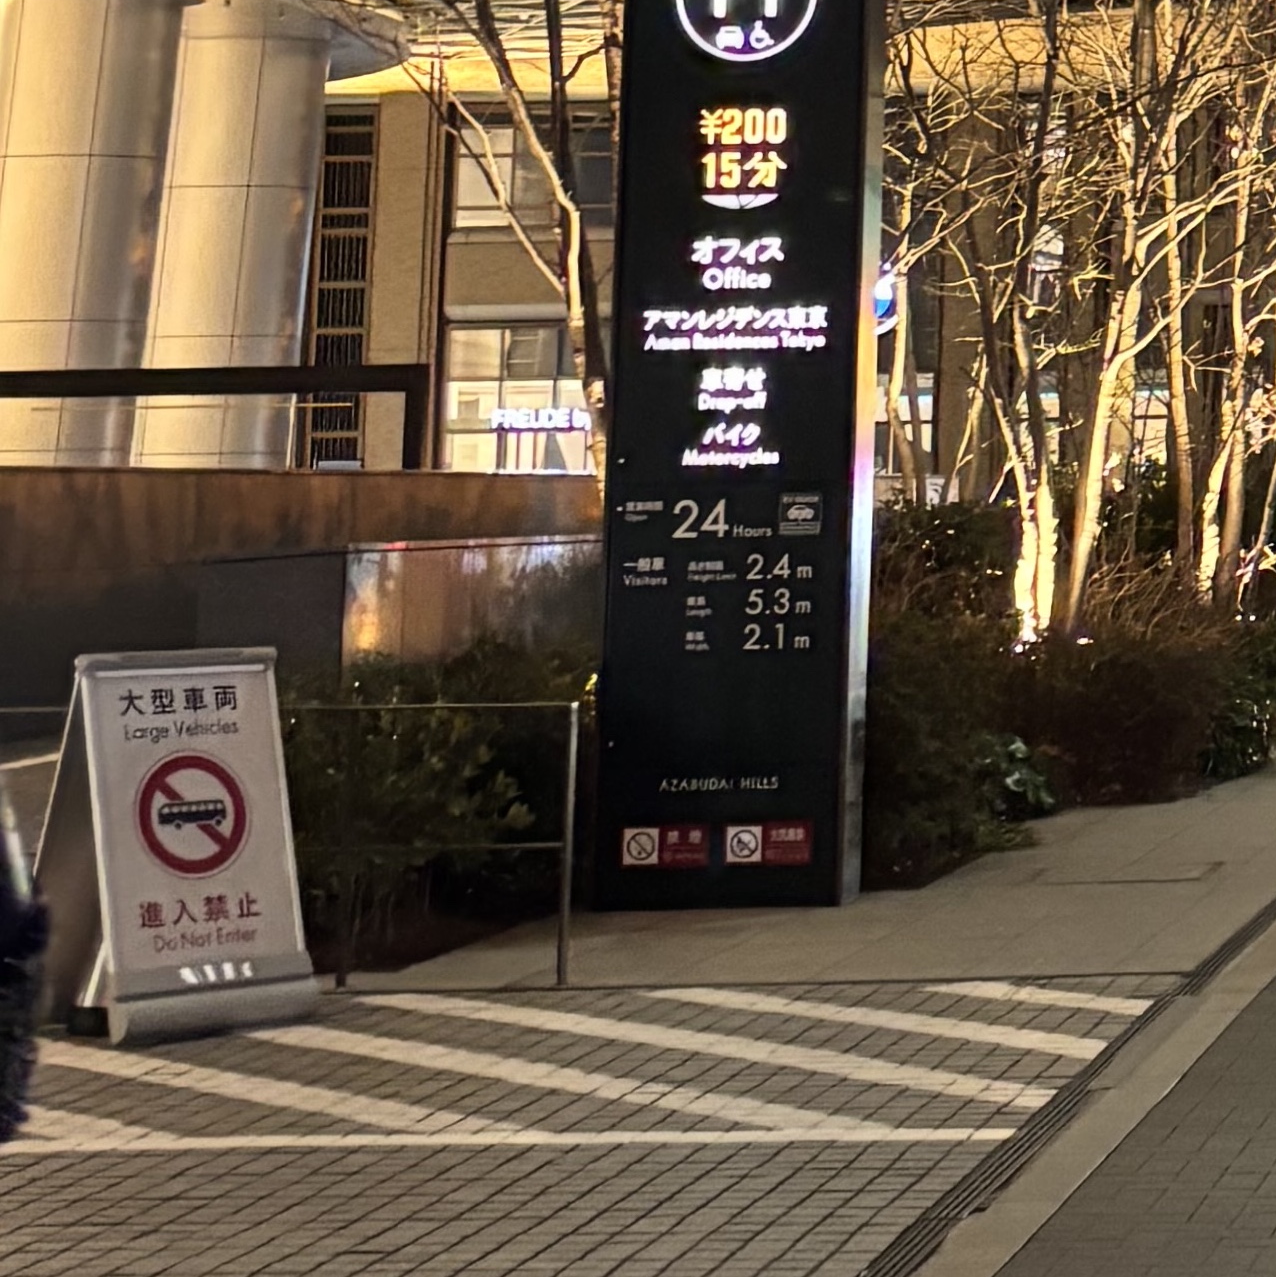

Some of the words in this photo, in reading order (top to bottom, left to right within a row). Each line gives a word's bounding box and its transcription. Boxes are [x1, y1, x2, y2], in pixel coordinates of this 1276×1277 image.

[700, 108, 787, 144] ¥200
[701, 151, 787, 189] 15分
[691, 235, 785, 265] オフィス
[702, 266, 772, 290] Office
[491, 408, 571, 430] FREUDE
[702, 421, 761, 447] バイク
[681, 446, 780, 469] Motorcycles
[671, 497, 729, 538] 24
[733, 524, 773, 538] Hours
[746, 552, 791, 581] 2.4
[796, 565, 813, 579] m
[623, 574, 668, 587] Visitors
[744, 587, 791, 615] 5.3
[794, 600, 812, 614] m
[742, 623, 785, 650] 2.1
[793, 635, 810, 649] m
[119, 685, 237, 716] 大型車両
[123, 723, 170, 744] Large
[173, 718, 239, 737] Vehicles
[659, 777, 734, 792] AZABUDAI
[741, 775, 779, 790] HILLS
[139, 891, 262, 929] 進入禁止
[153, 934, 178, 953] Do
[180, 930, 212, 950] Not
[216, 926, 258, 946] Enter
